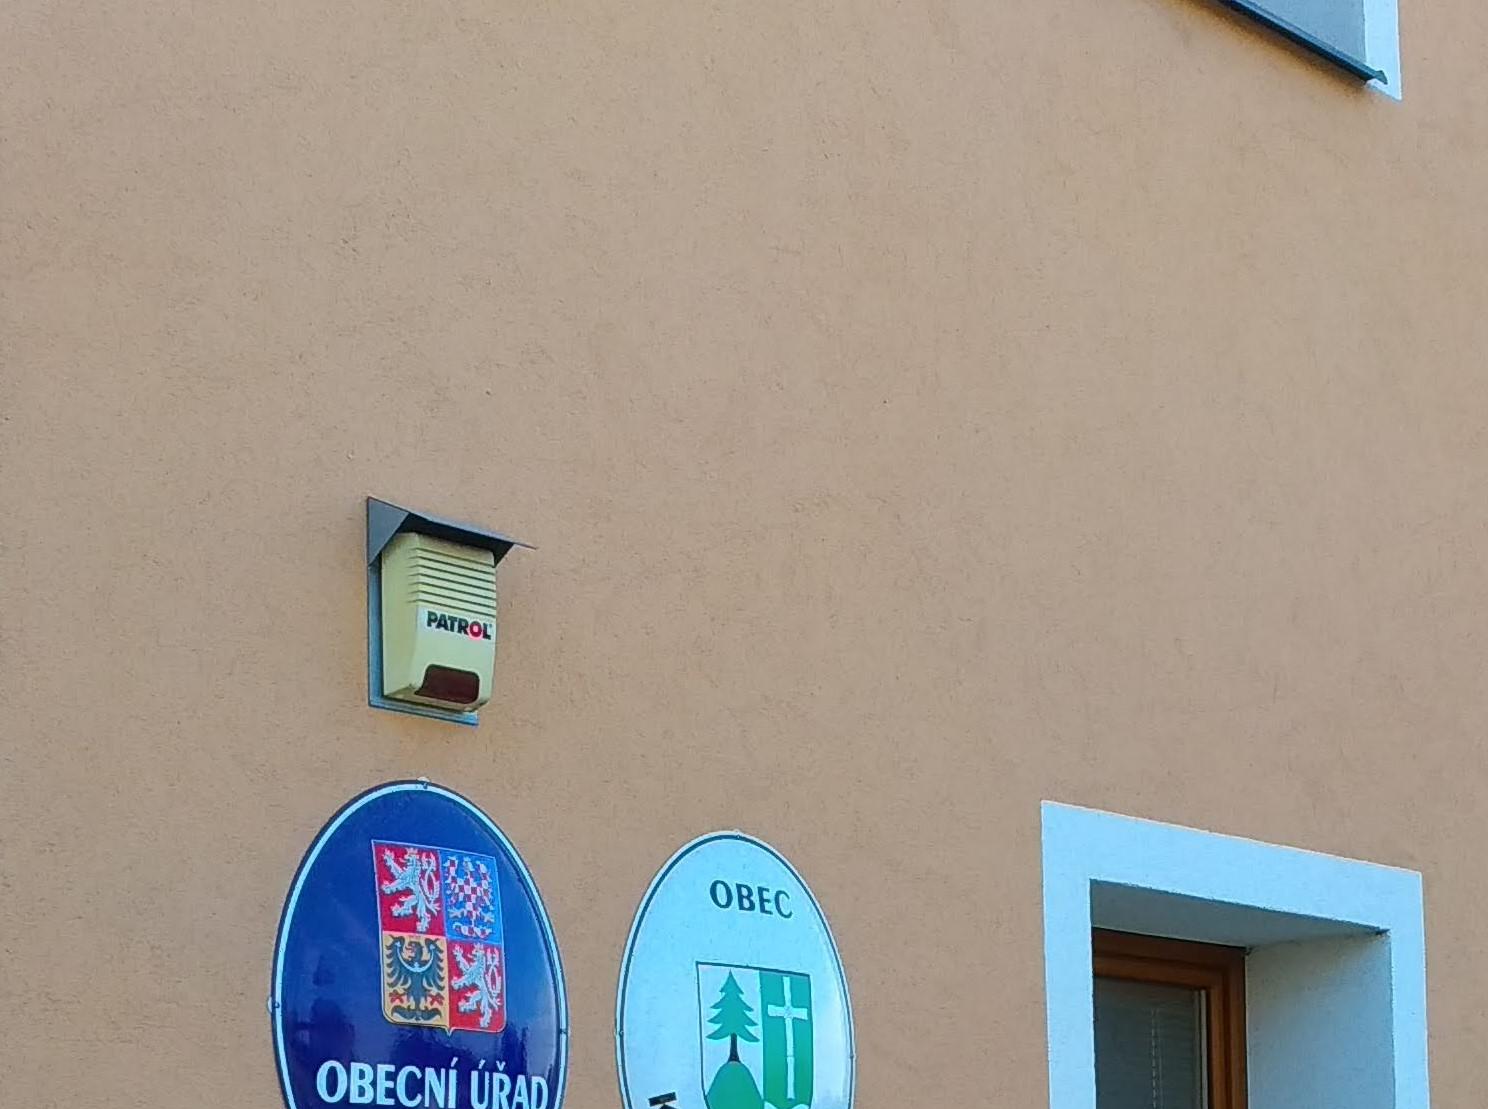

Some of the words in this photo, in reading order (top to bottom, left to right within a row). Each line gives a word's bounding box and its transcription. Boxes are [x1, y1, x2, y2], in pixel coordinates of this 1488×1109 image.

[427, 610, 492, 640] PATROL
[709, 879, 793, 919] OBEC
[316, 1056, 458, 1109] OBECNÍ
